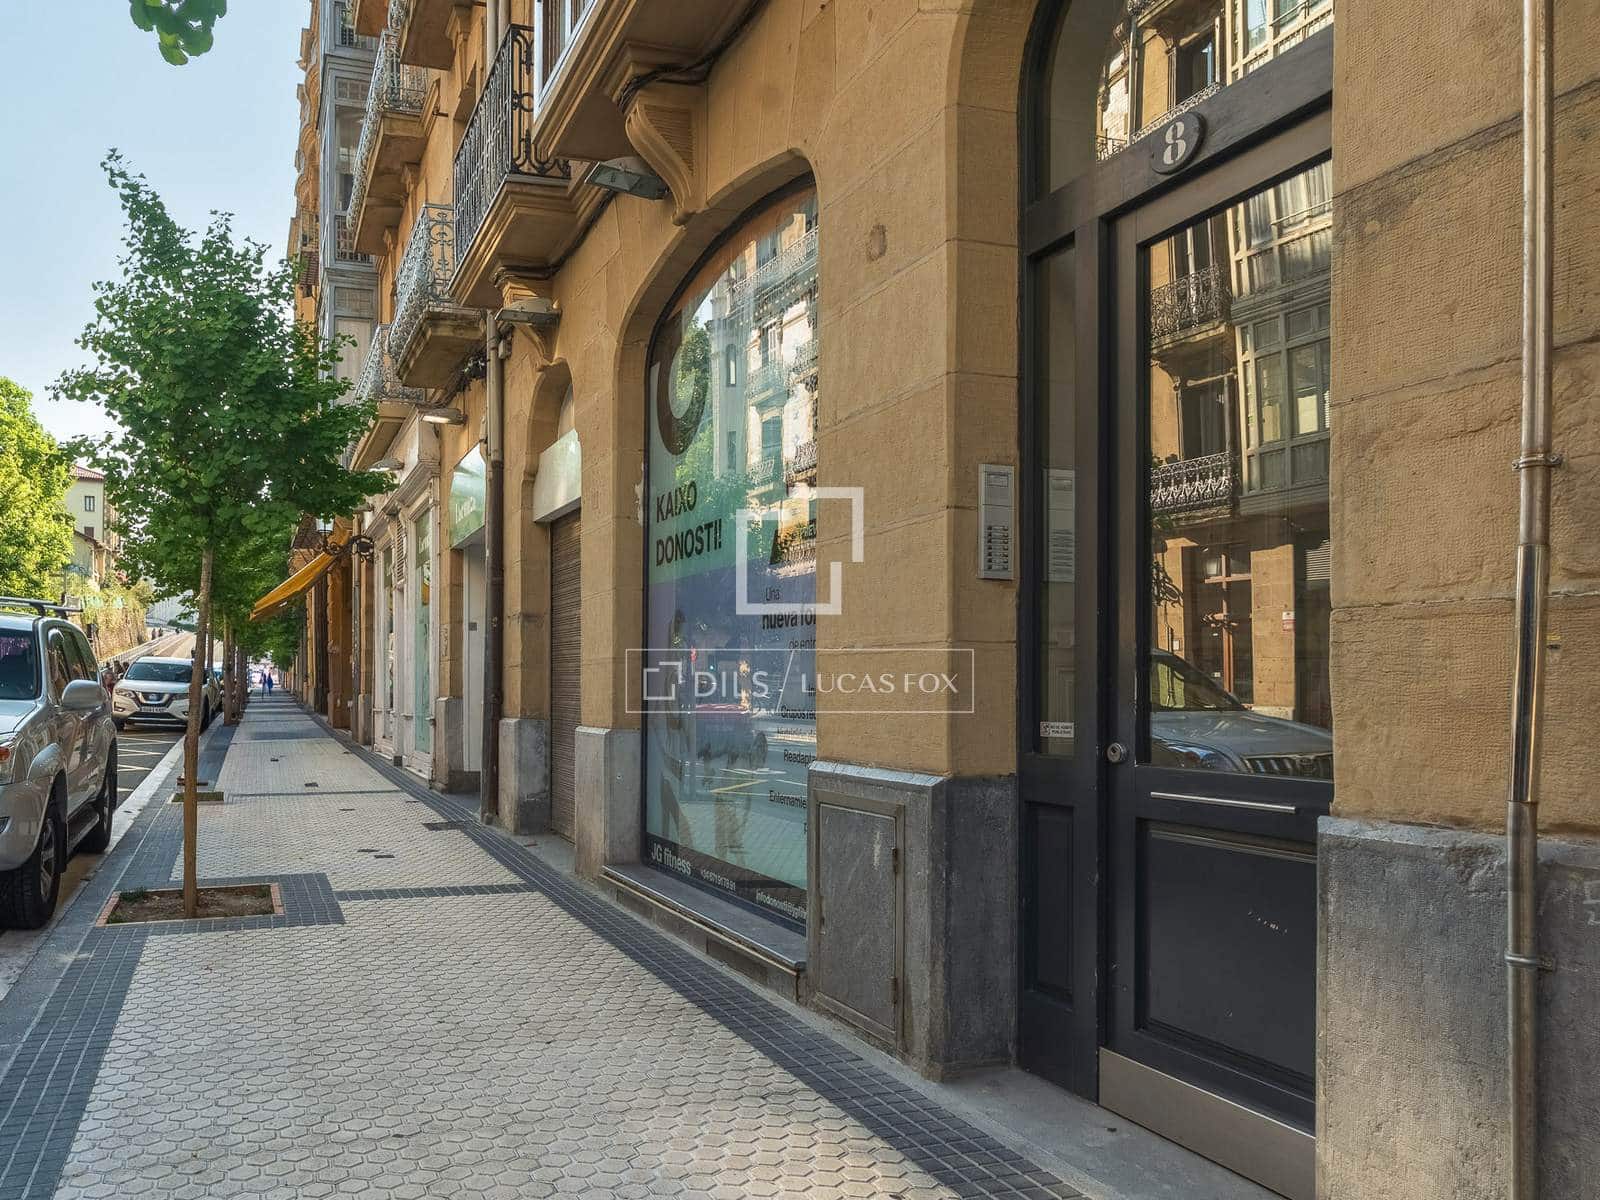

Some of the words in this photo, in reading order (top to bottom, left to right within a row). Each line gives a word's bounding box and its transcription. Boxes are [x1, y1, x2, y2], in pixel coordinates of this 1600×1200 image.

[1163, 121, 1187, 165] 8
[656, 481, 698, 524] KAIXO
[655, 518, 722, 567] DONOSTI!
[765, 587, 781, 601] Una
[762, 606, 798, 630] nueva
[663, 846, 691, 876] fitness
